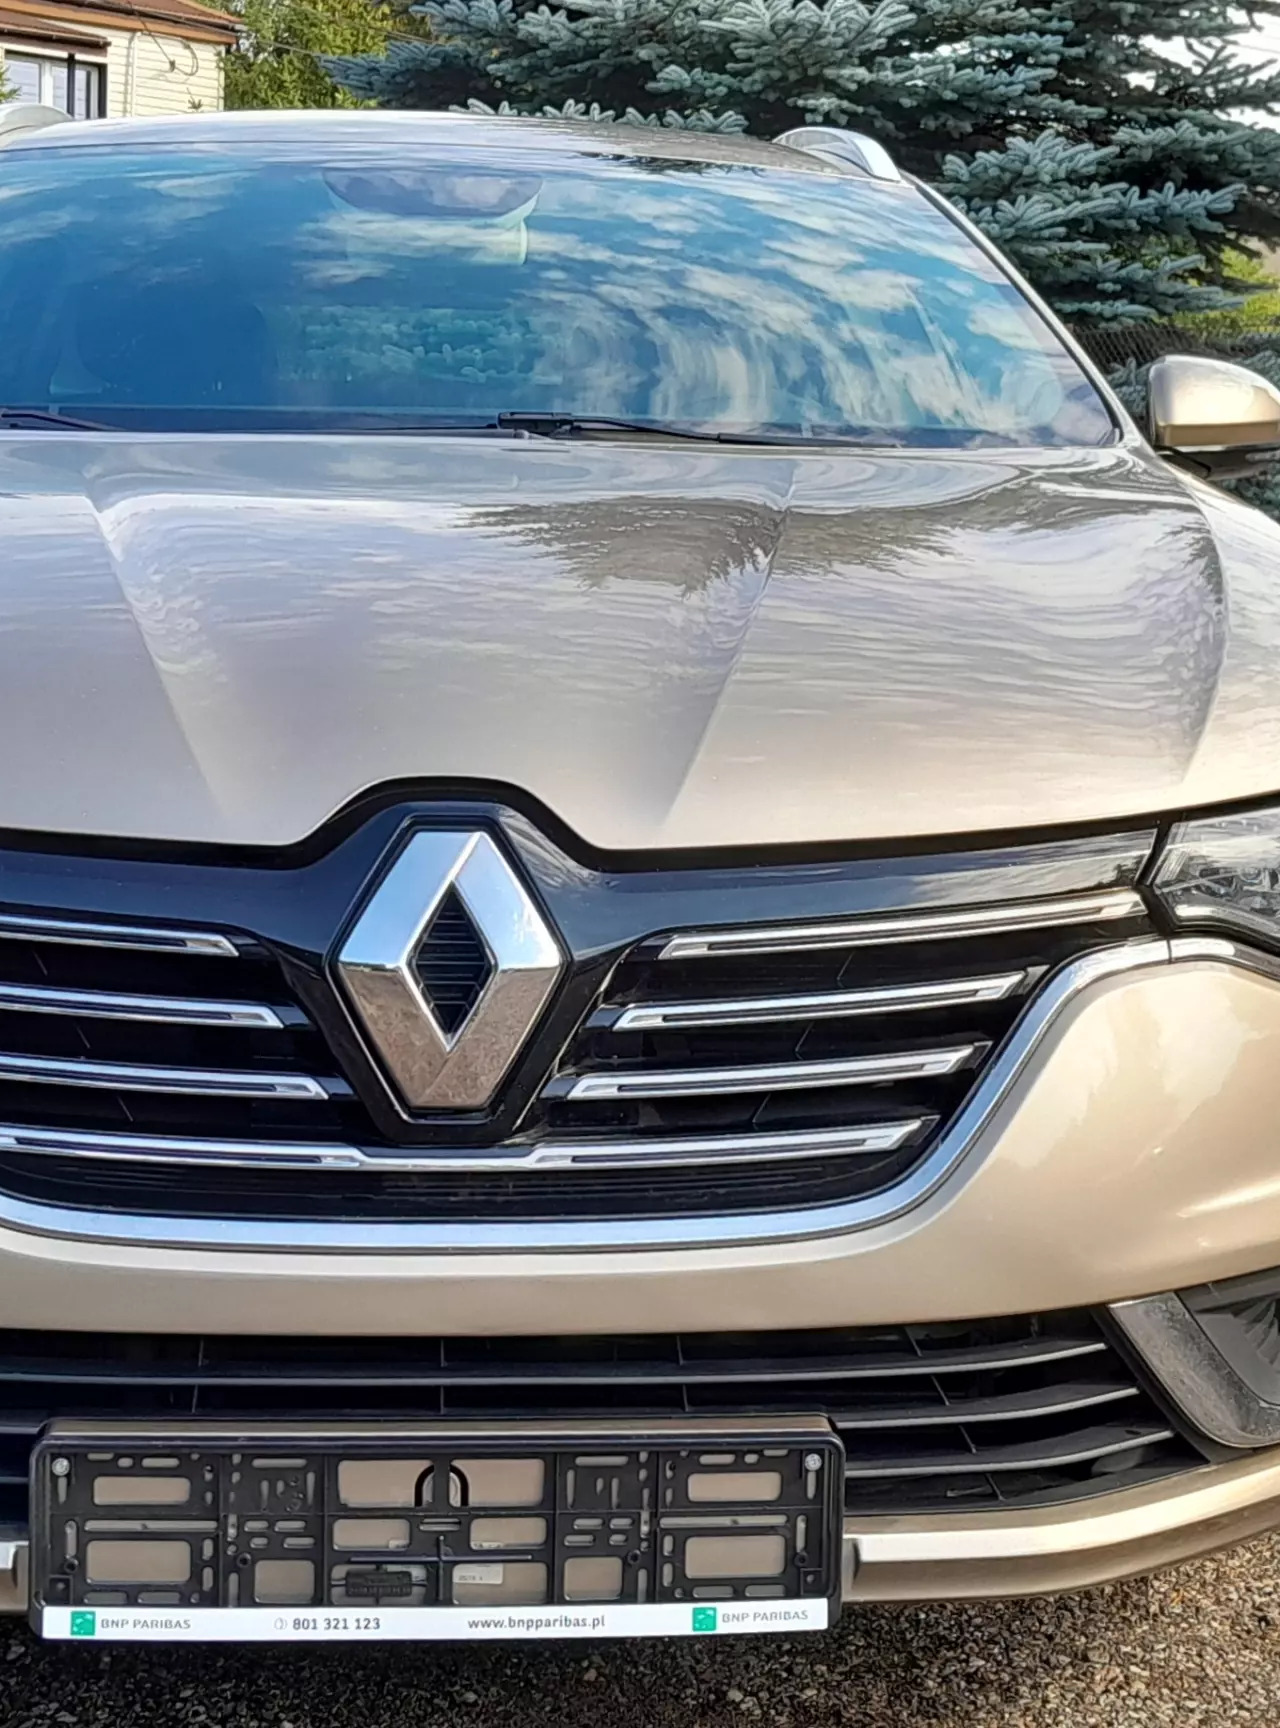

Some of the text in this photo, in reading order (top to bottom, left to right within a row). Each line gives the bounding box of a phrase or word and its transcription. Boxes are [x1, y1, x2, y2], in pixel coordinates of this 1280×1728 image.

[100, 1618, 192, 1630] BNP PARIBAS
[292, 1616, 381, 1631] 801 321 123
[467, 1614, 606, 1631] www.bnpparibas.pl
[721, 1609, 809, 1624] BNP PARIBAS
